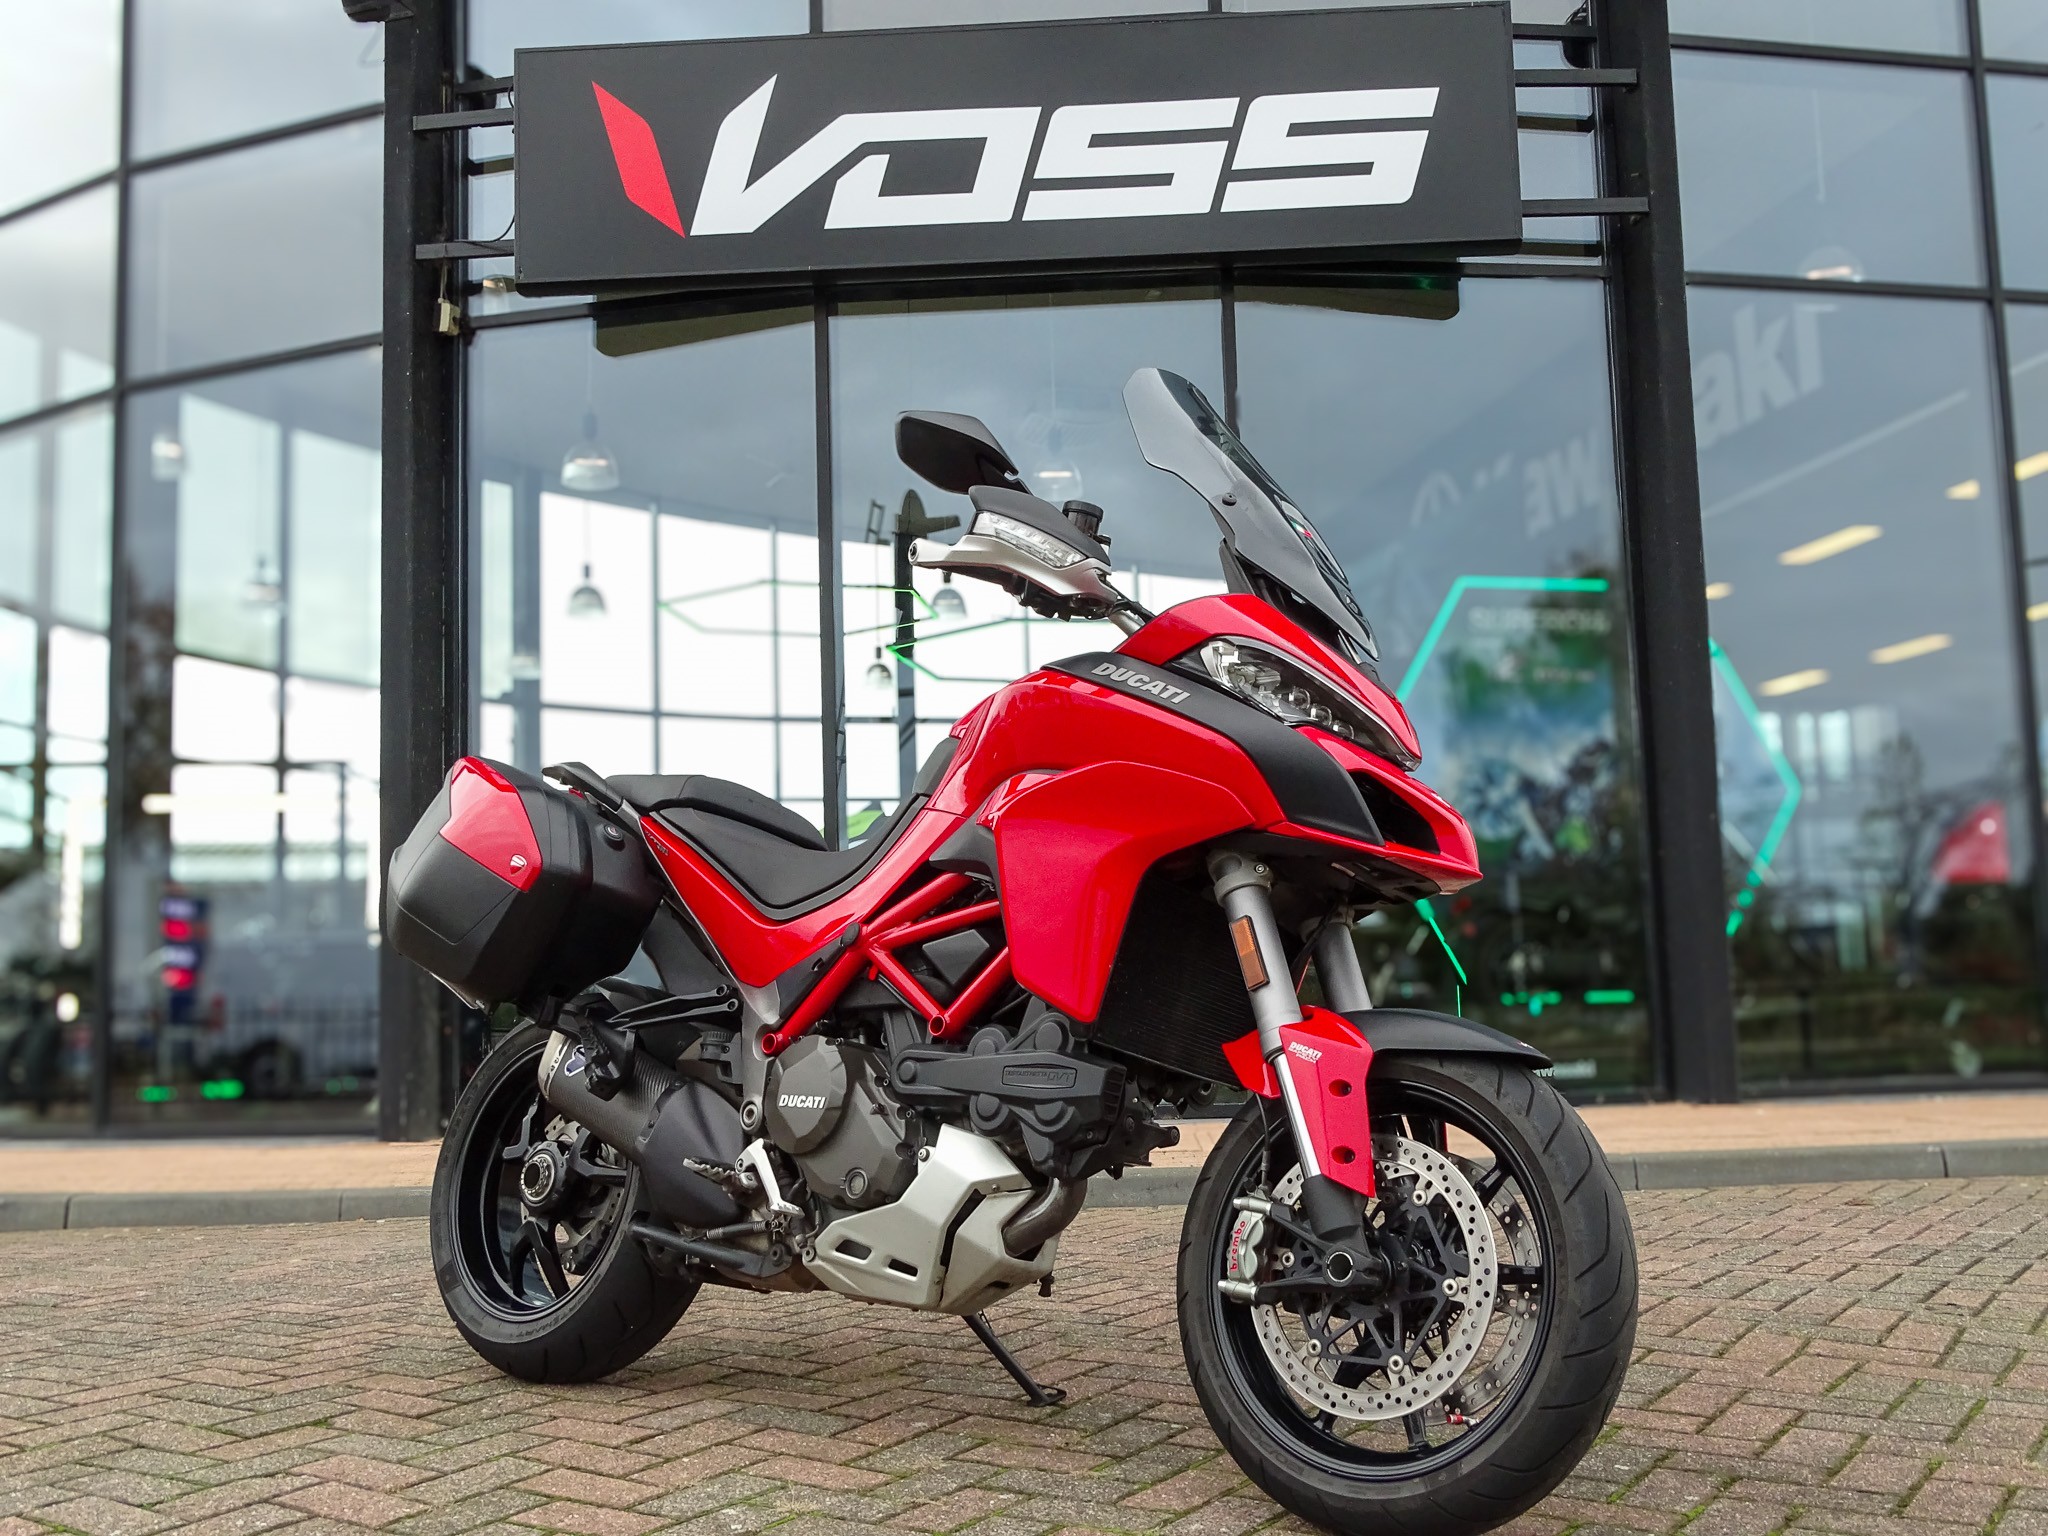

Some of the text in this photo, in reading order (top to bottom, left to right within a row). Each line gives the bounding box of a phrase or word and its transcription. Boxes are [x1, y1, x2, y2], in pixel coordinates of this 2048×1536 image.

[591, 73, 1440, 238] VOSS
[1091, 662, 1191, 704] DUCATI
[1288, 1041, 1323, 1059] DUCATI
[779, 1094, 826, 1109] DUCATI
[1230, 1221, 1246, 1271] brembo
